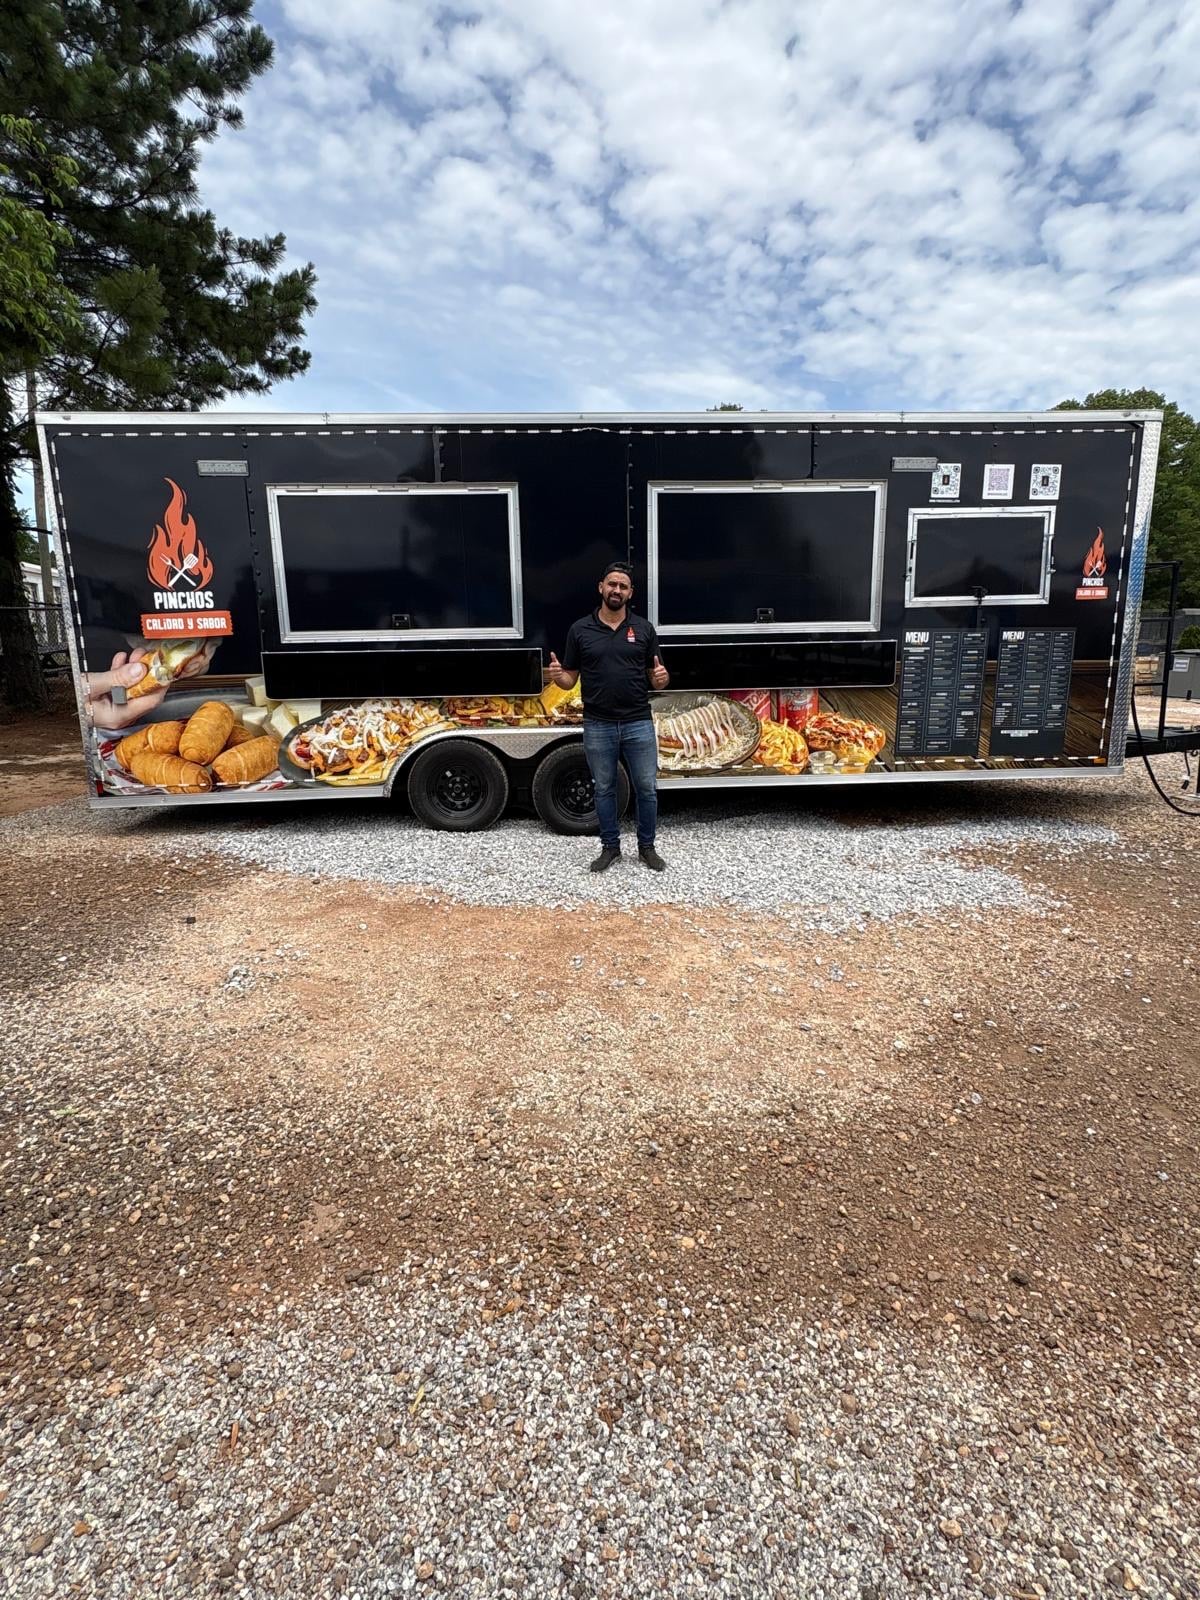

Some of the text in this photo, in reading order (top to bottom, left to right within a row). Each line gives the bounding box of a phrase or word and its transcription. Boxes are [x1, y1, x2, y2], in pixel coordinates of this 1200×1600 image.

[153, 591, 214, 609] PINCHOS
[196, 617, 227, 630] SABOR
[905, 631, 930, 643] MENU
[1002, 630, 1025, 641] MENU
